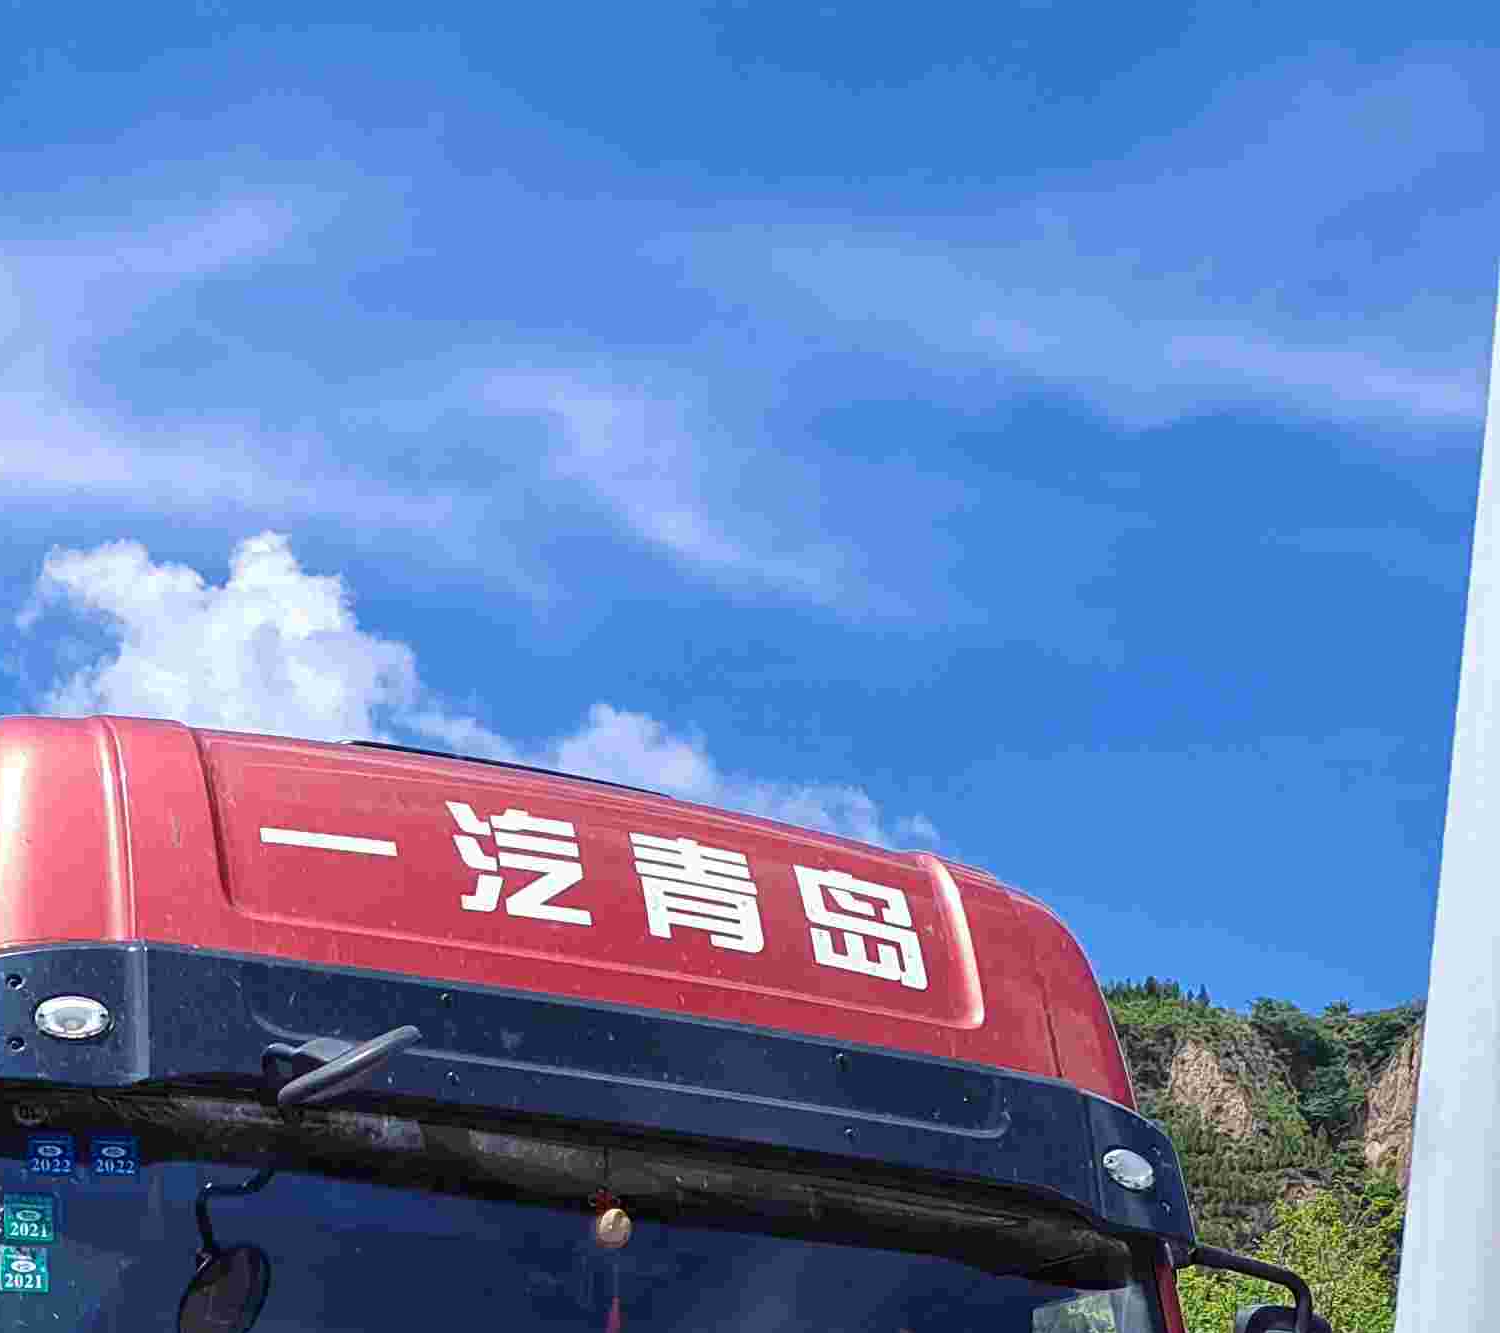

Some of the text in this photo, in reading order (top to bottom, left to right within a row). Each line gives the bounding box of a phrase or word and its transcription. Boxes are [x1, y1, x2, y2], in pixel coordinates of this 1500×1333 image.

[260, 801, 928, 991] 一汽青岛
[31, 1158, 71, 1173] 2022
[96, 1159, 135, 1175] 2022
[9, 1222, 48, 1238] 2021
[3, 1273, 43, 1289] 2021
